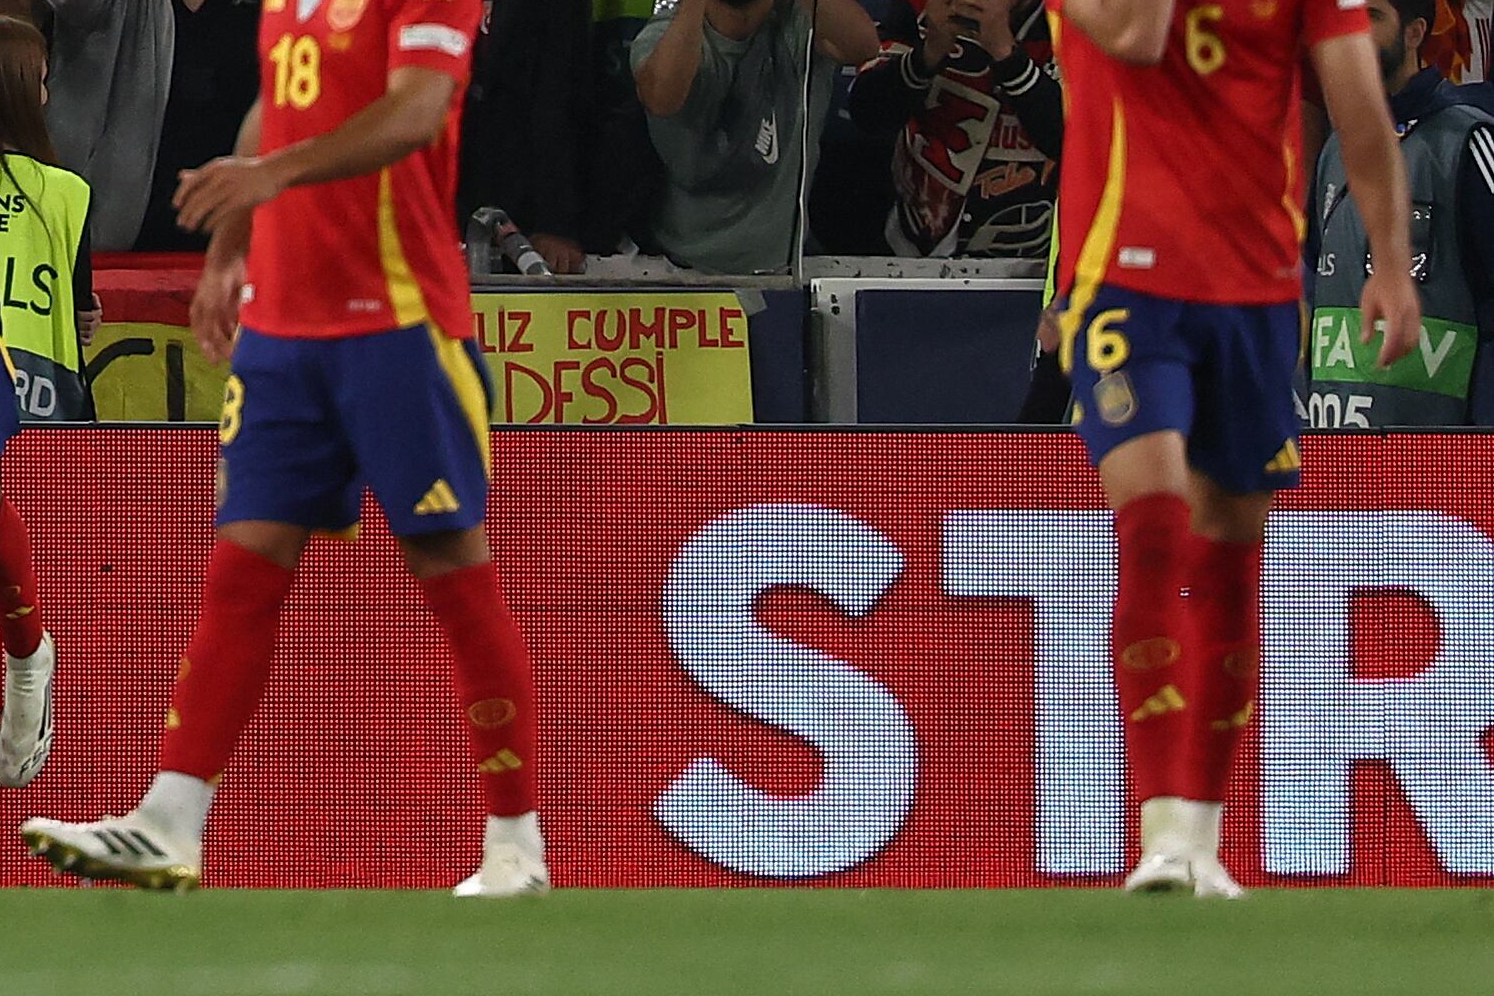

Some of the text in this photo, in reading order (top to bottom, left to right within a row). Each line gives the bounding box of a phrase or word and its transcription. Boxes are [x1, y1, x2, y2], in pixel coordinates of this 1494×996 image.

[269, 32, 322, 109] 18
[1185, 4, 1227, 77] 6
[567, 307, 745, 352] CUMPLE
[1086, 308, 1131, 372] 6
[1312, 315, 1355, 368] FA
[653, 503, 1494, 880] STR
